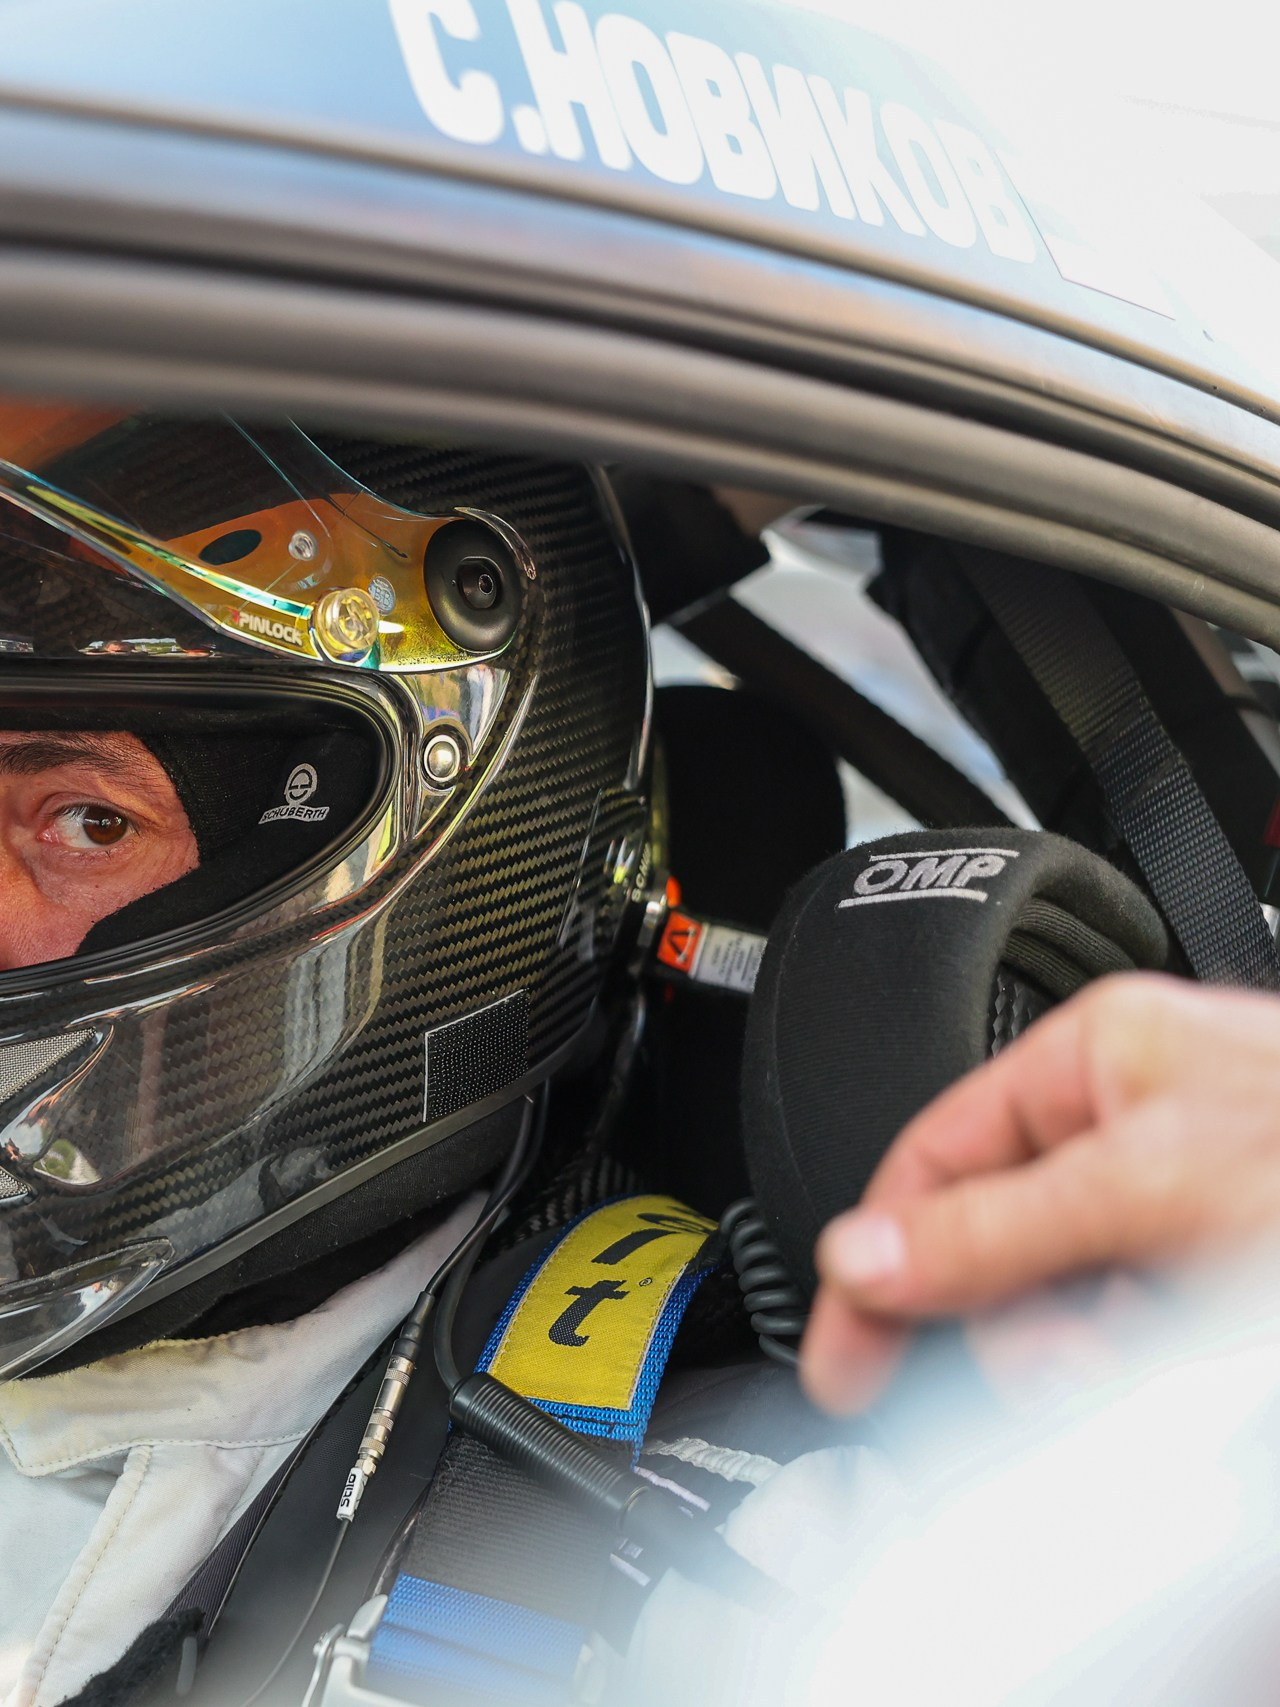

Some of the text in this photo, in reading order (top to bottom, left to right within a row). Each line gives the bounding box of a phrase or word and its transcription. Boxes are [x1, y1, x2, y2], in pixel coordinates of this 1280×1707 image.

[239, 611, 302, 645] PINLOCK
[262, 806, 327, 821] SCHUBERTH
[853, 855, 1006, 896] OMP
